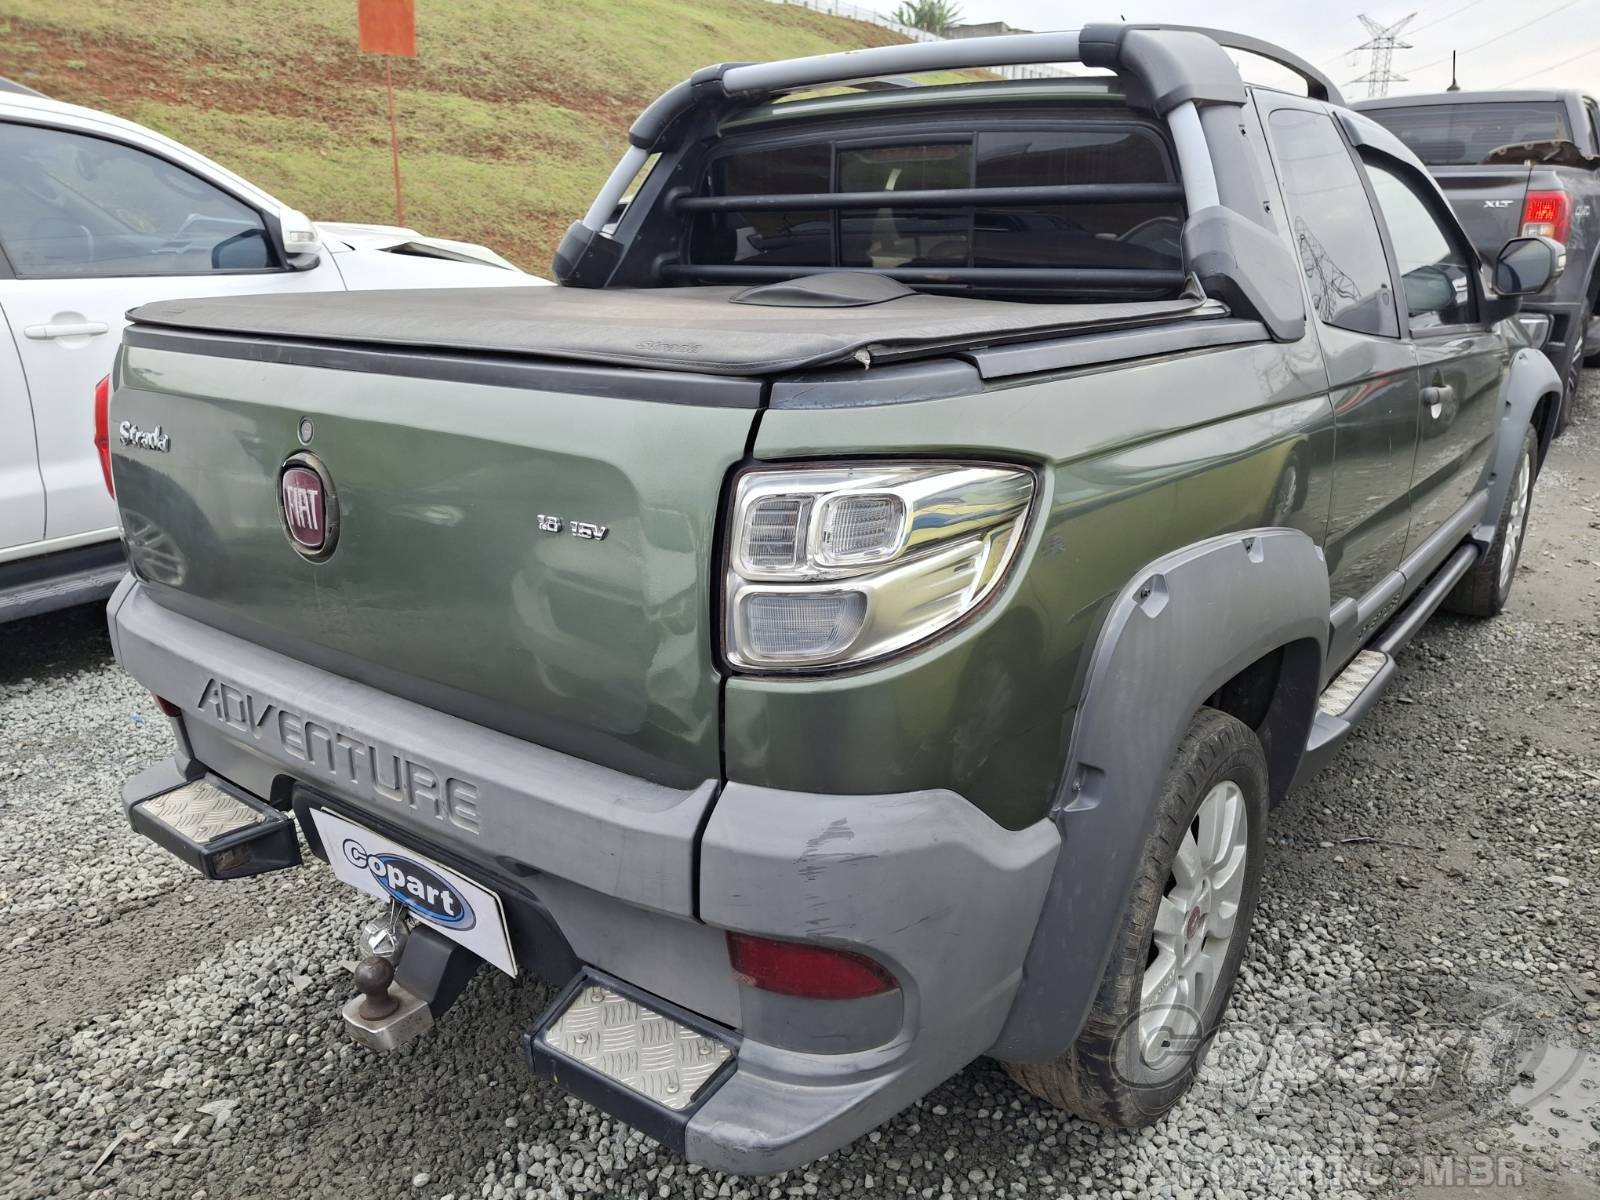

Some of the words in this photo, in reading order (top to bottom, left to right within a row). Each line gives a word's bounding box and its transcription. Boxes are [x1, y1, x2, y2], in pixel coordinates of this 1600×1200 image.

[1483, 199, 1513, 208] XLT
[119, 420, 171, 453] Strada
[286, 485, 319, 531] FIAT
[569, 520, 608, 541] 16V
[197, 678, 480, 835] ADVENTURE
[342, 838, 455, 917] Copart
